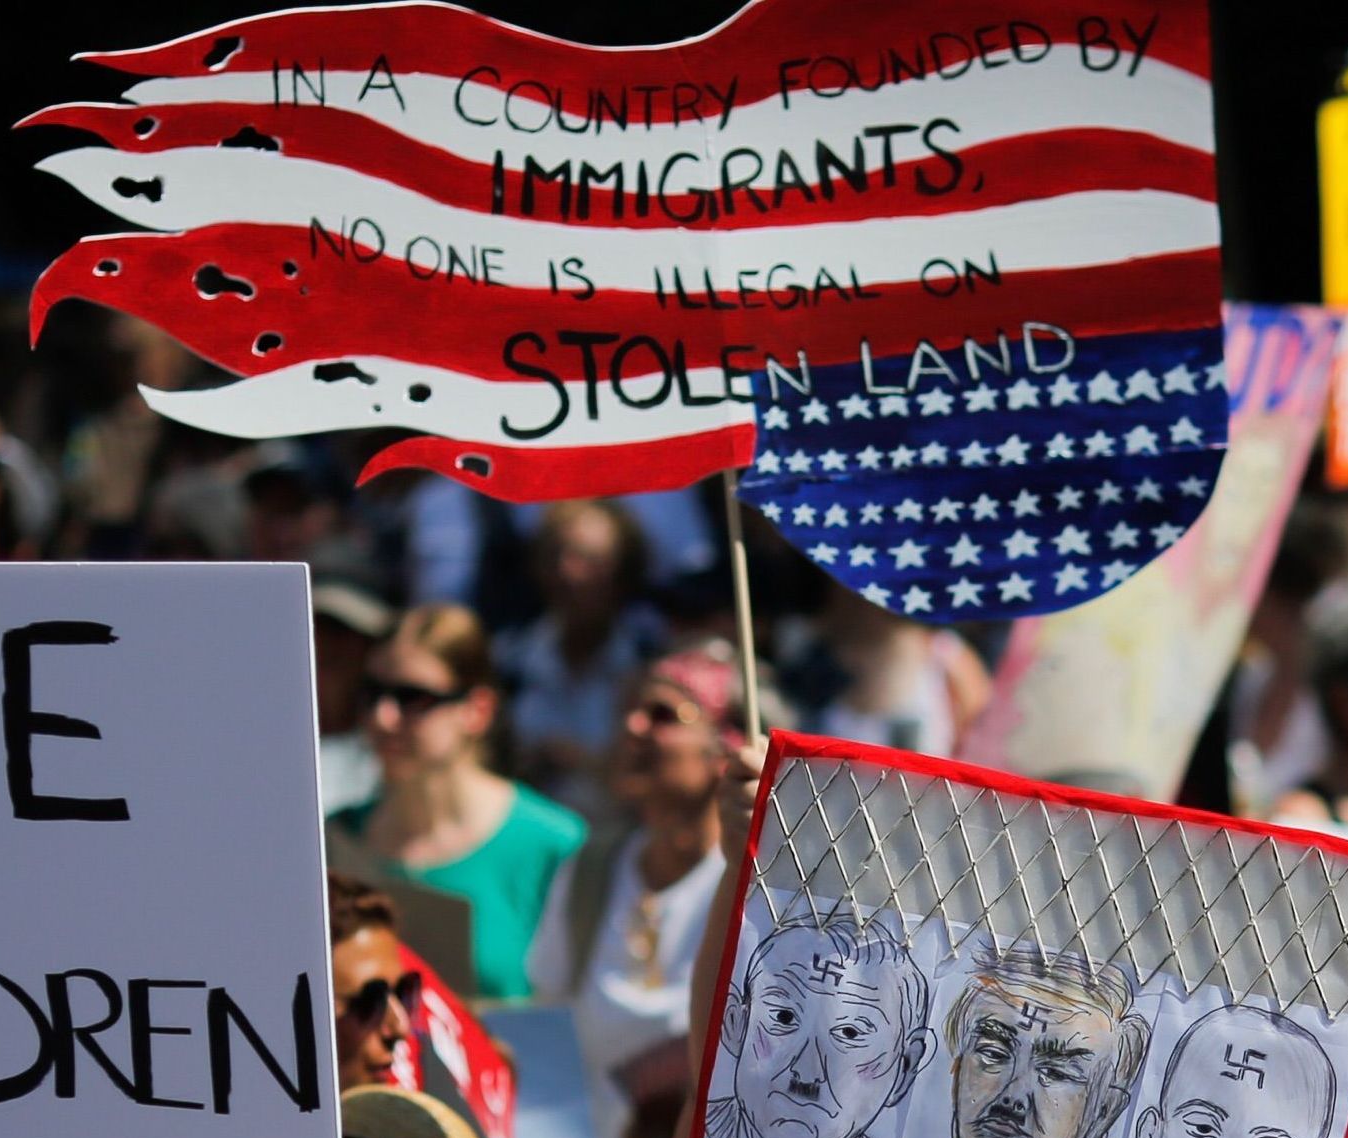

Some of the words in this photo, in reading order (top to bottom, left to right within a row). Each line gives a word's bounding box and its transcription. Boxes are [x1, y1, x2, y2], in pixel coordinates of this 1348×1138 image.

[272, 58, 325, 107] IN
[358, 55, 406, 111] A
[454, 66, 738, 135] COUNTRY
[779, 20, 1051, 109] FOUNDED
[1076, 15, 1159, 76] BY
[492, 117, 983, 223] IMMIGRANTS,
[310, 216, 386, 263] NO
[405, 236, 504, 286] ONE
[550, 256, 595, 300] IS
[654, 263, 880, 311] ILLEGAL
[920, 250, 1002, 297] ON
[500, 331, 811, 440] STOLEN
[860, 320, 1076, 397] LAND
